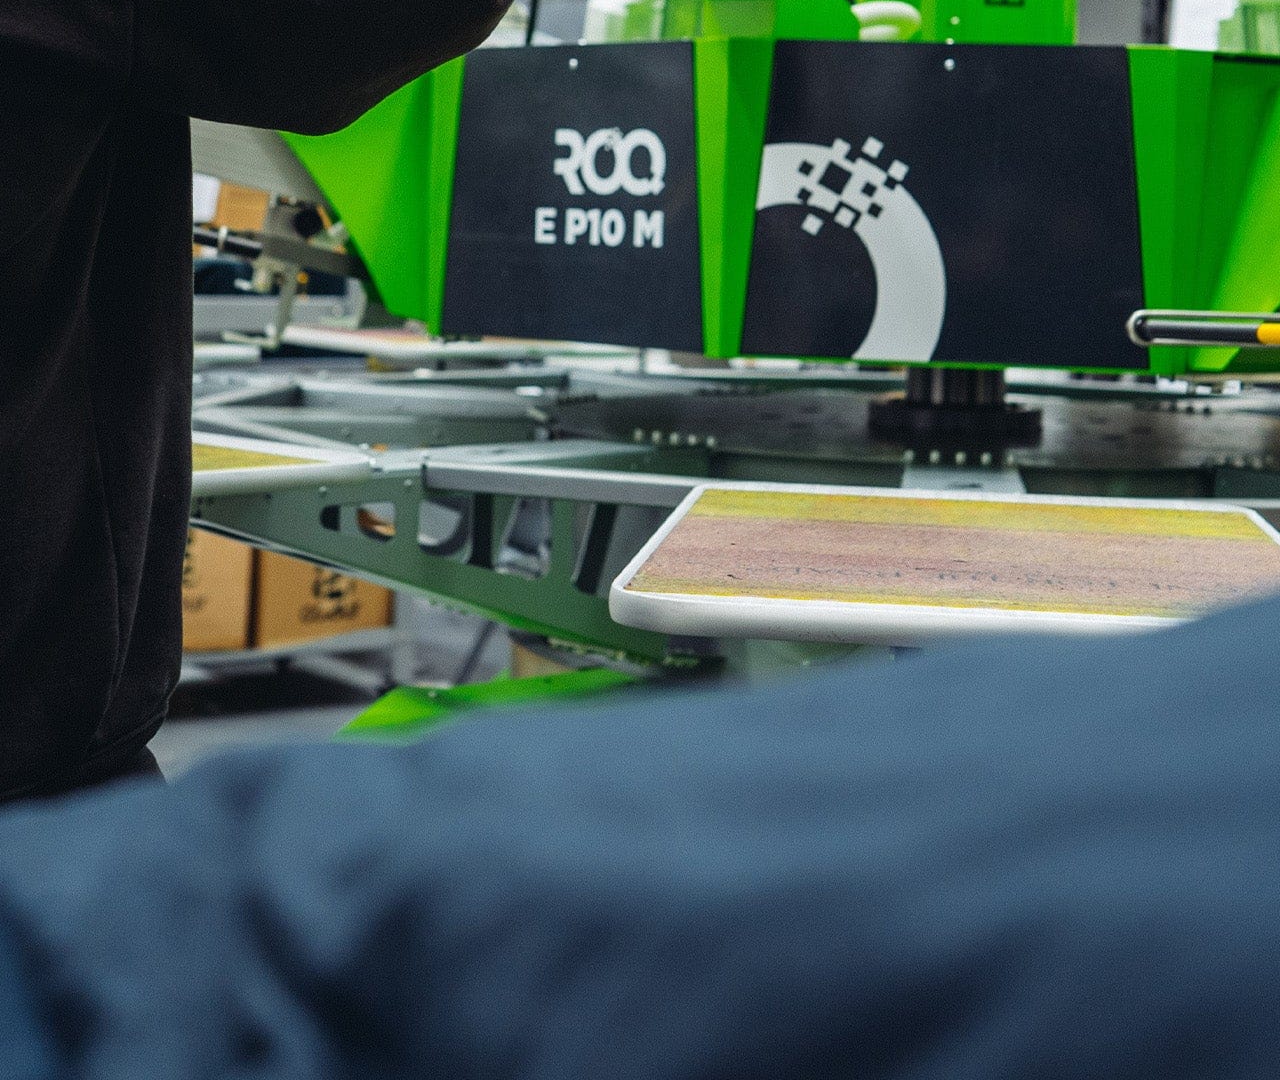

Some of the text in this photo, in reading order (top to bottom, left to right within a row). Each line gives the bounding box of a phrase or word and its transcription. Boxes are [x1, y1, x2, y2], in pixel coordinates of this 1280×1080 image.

[553, 127, 667, 197] ROQ
[534, 206, 665, 249] E P10 M
